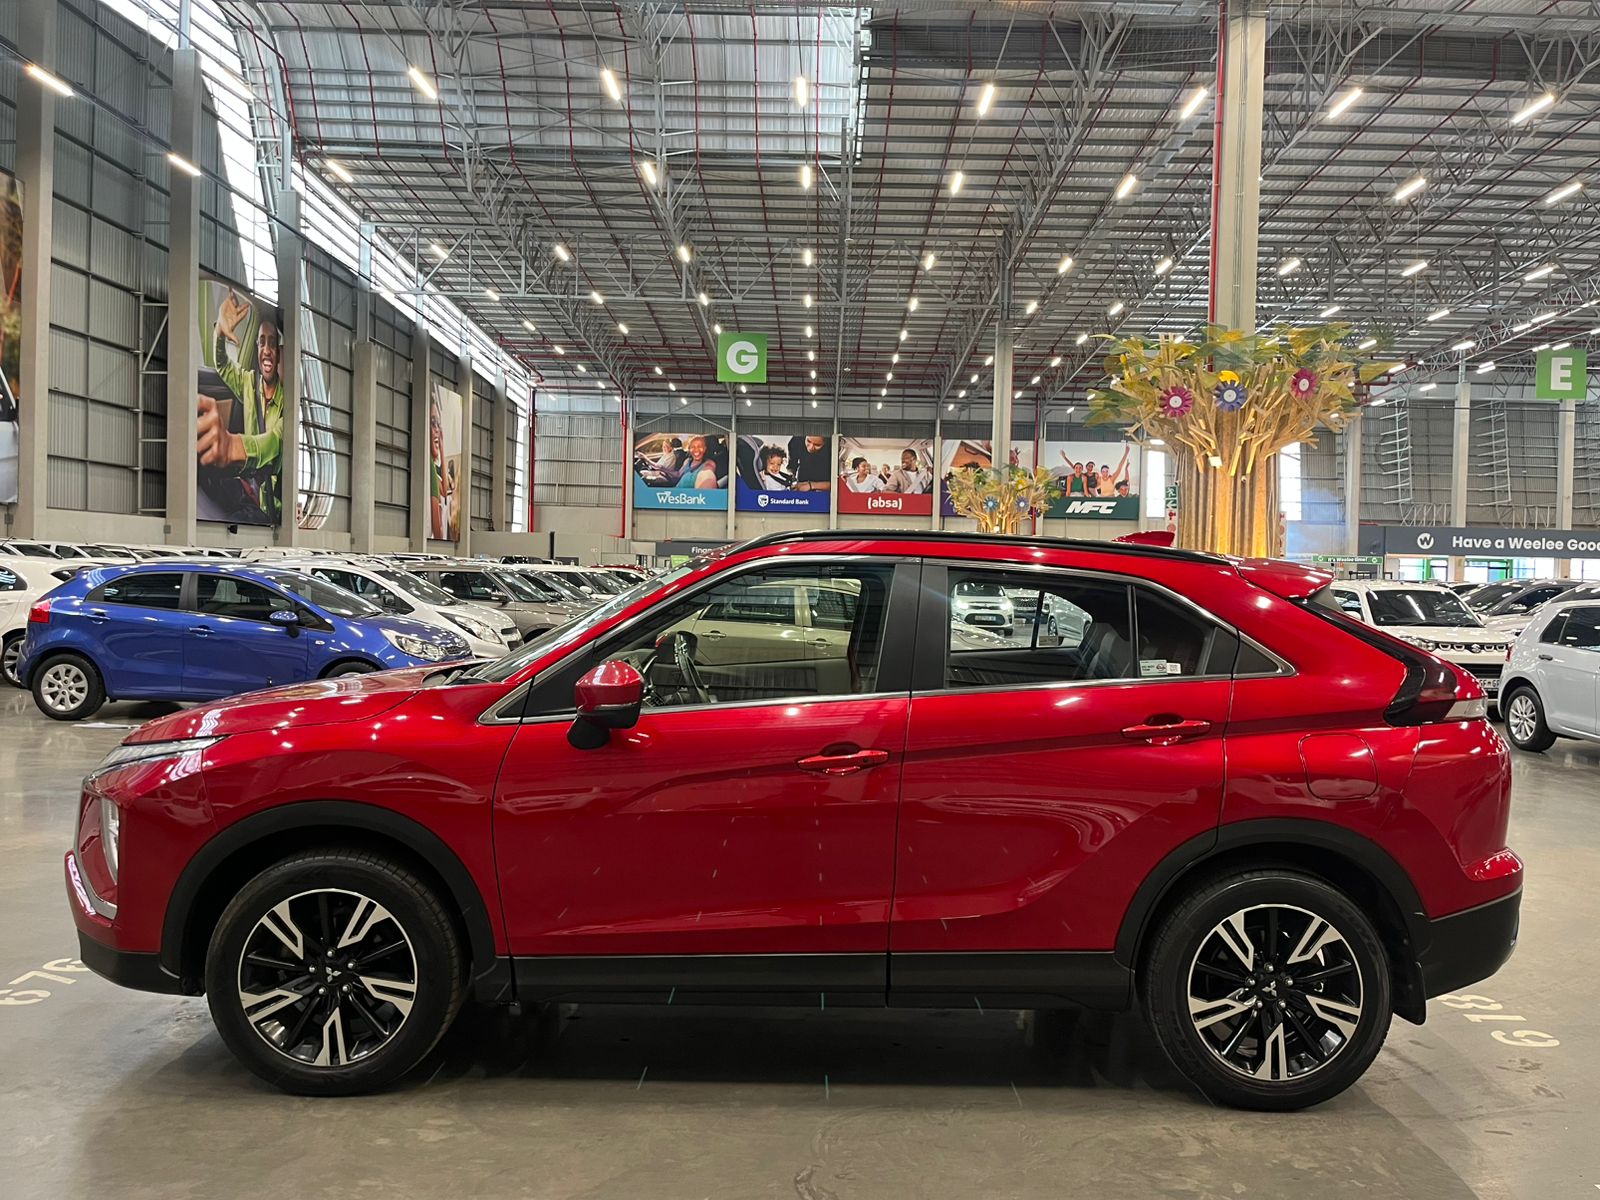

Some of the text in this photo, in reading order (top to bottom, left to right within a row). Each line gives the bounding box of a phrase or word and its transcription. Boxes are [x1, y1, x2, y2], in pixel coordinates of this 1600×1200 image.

[726, 340, 759, 375] G
[1550, 357, 1573, 391] E
[656, 491, 706, 505] WesBank
[867, 496, 903, 511] (absa)
[1065, 501, 1117, 514] MFC
[1452, 535, 1492, 549] Have
[1494, 538, 1505, 549] a
[1507, 537, 1564, 550] Weelee
[1436, 994, 1561, 1048] 618
